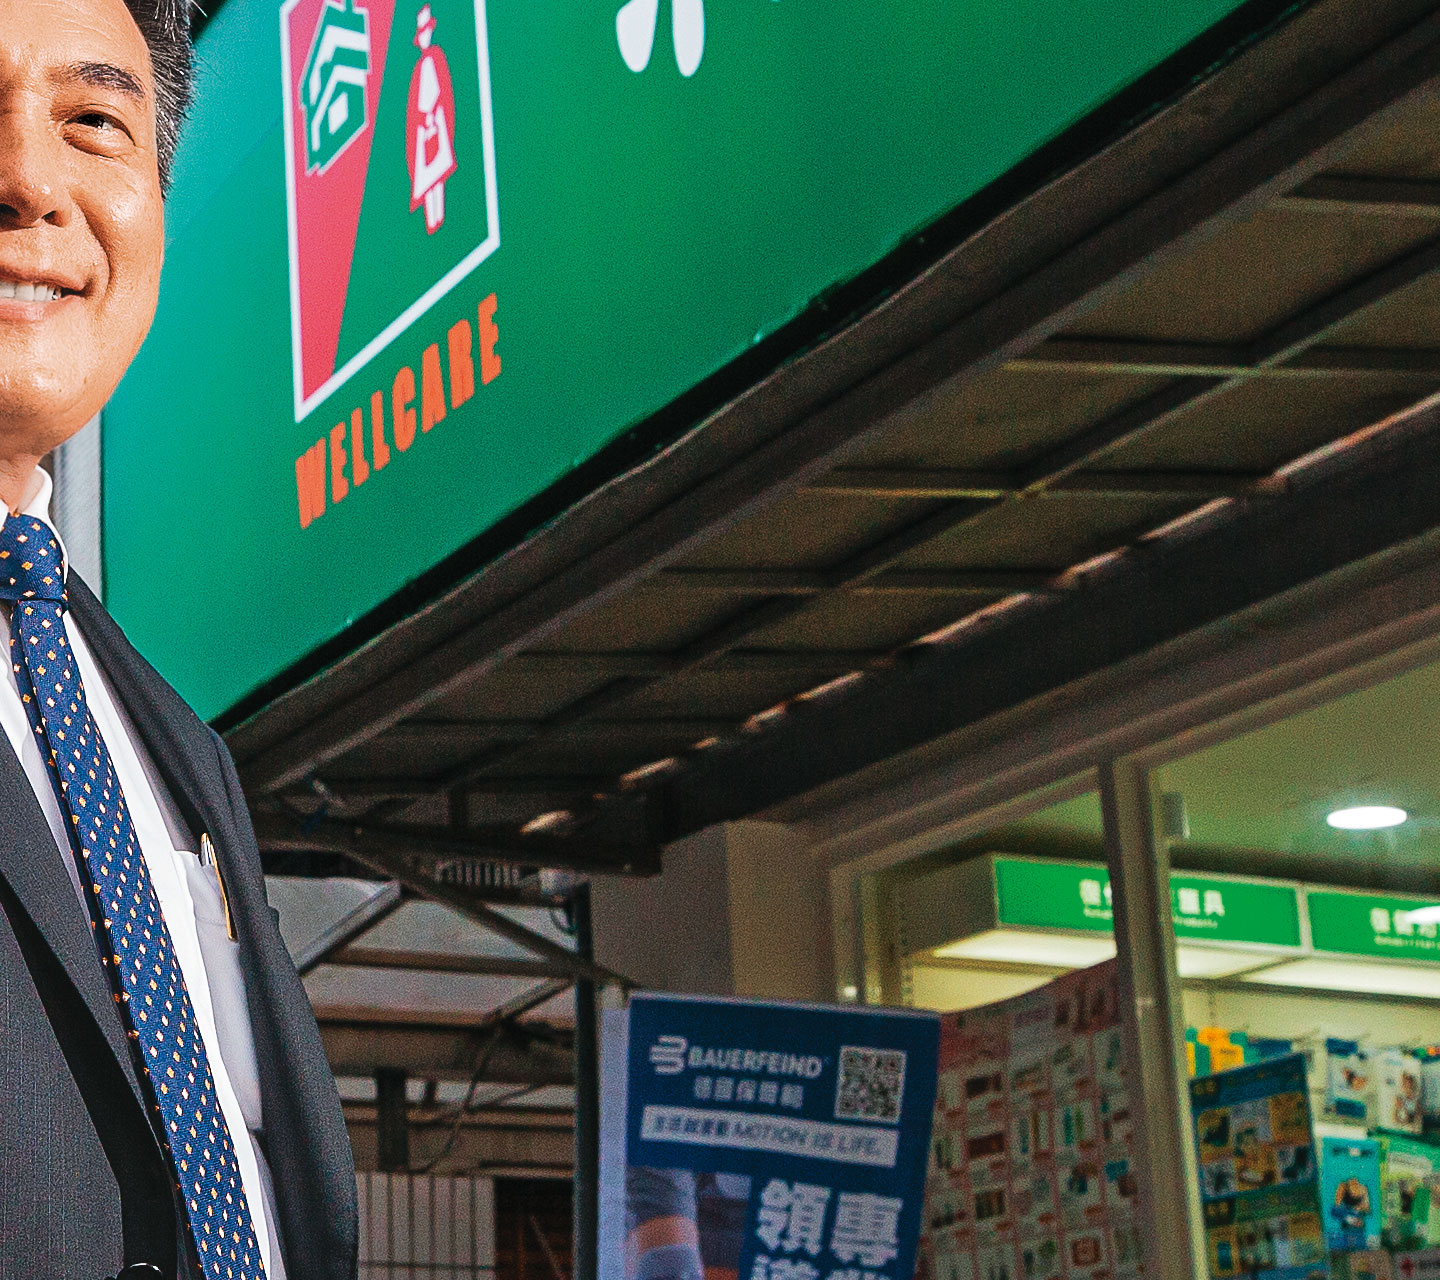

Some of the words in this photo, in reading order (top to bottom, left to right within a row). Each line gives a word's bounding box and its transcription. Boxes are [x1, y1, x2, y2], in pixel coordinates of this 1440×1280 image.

[295, 293, 502, 529] WELLCARE
[688, 1045, 822, 1078] BAUERFEIND
[734, 1122, 807, 1146] MOTION
